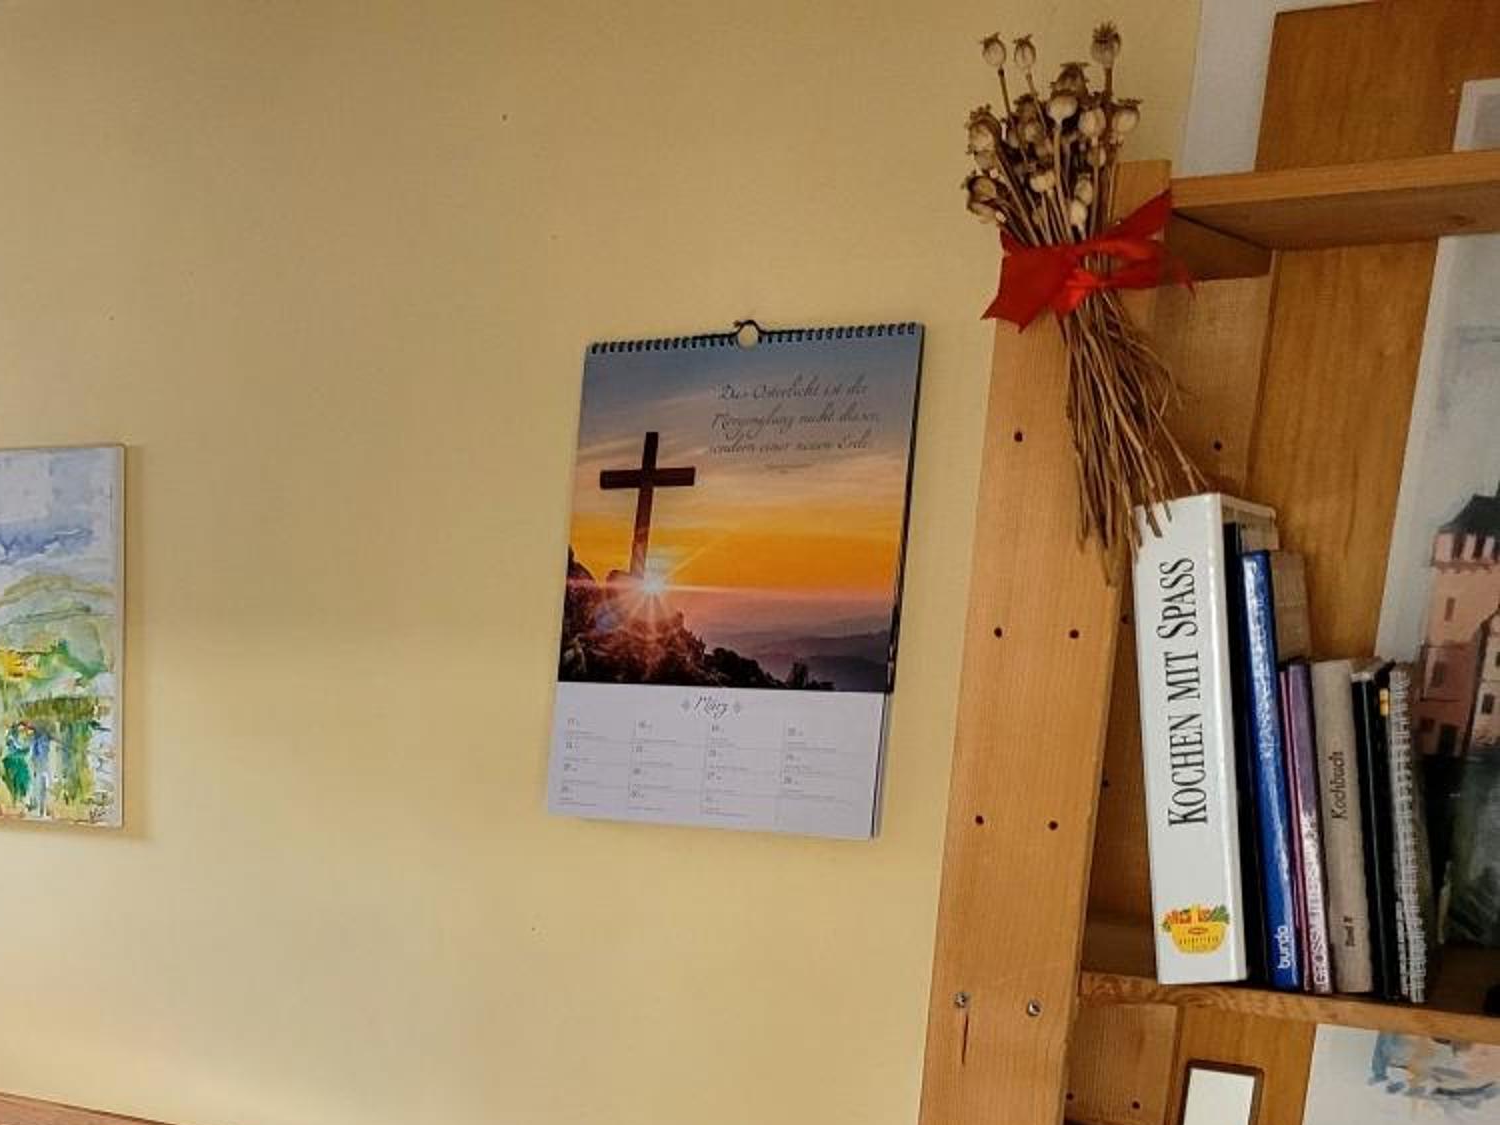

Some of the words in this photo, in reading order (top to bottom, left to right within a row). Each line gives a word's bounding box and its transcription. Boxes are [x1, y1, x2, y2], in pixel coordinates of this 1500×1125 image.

[1155, 558, 1198, 639] SPASS
[1163, 650, 1201, 702] MIT
[1167, 713, 1209, 826] KOCHEN
[1328, 751, 1349, 820] Kochbuch
[1274, 924, 1291, 970] burda
